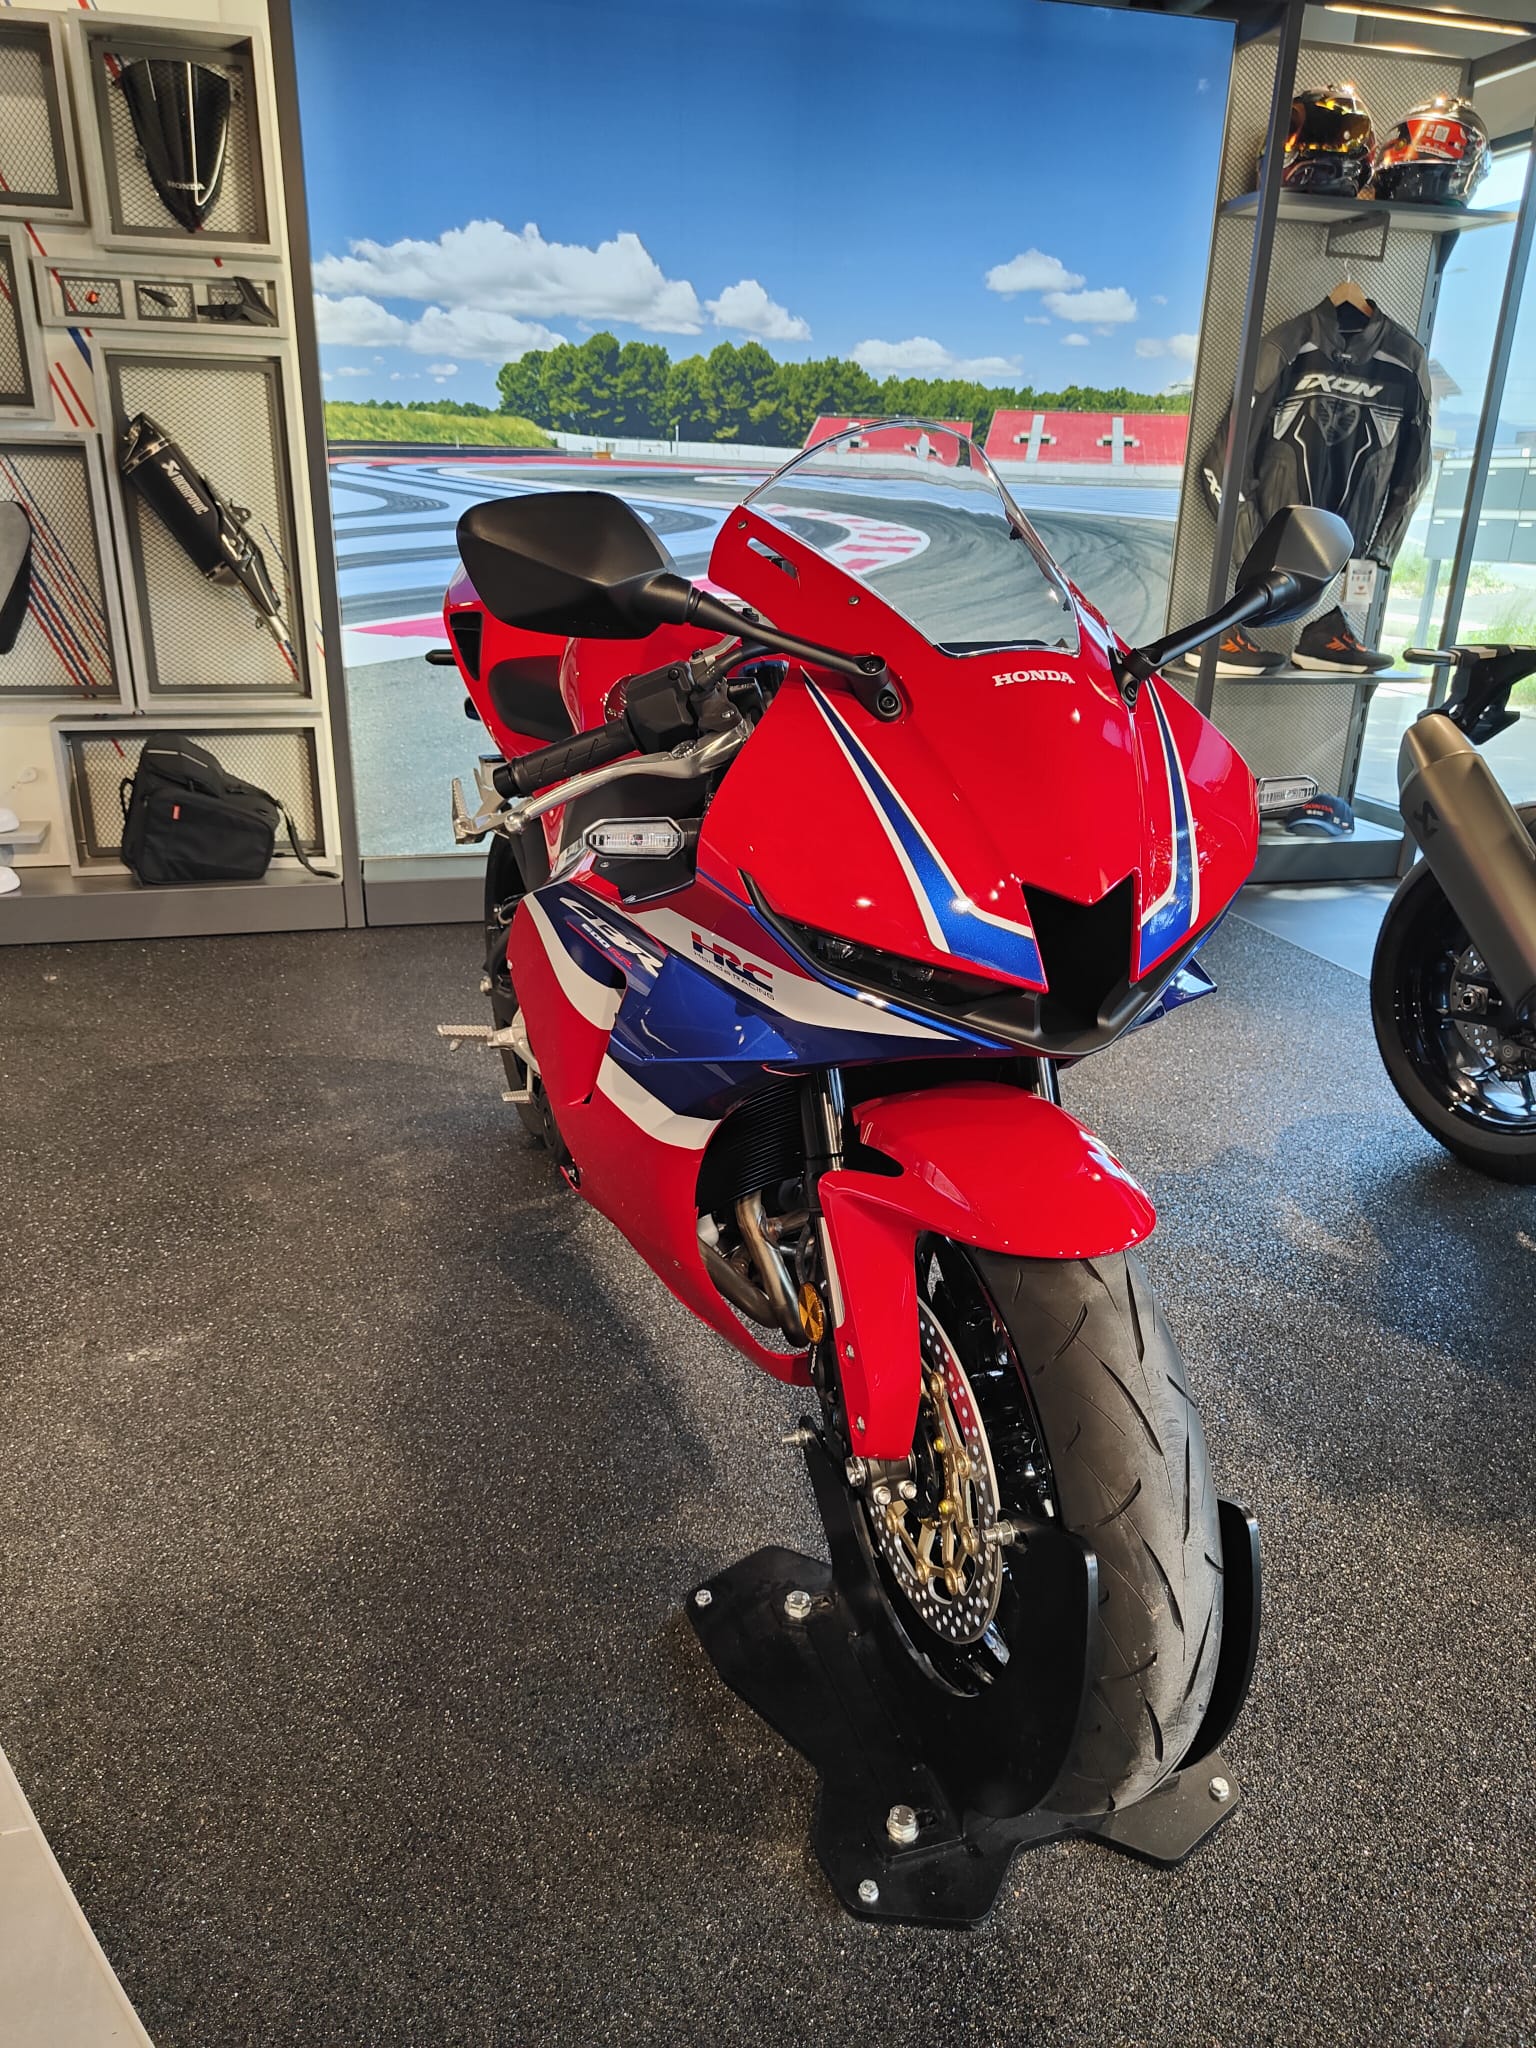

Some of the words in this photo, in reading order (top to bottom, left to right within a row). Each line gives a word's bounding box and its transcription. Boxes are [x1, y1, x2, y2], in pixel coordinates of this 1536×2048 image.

[167, 180, 206, 191] HONDA
[1295, 373, 1384, 398] IXON
[992, 669, 1076, 687] HONDA
[559, 897, 664, 978] CBR
[691, 931, 773, 993] HRC
